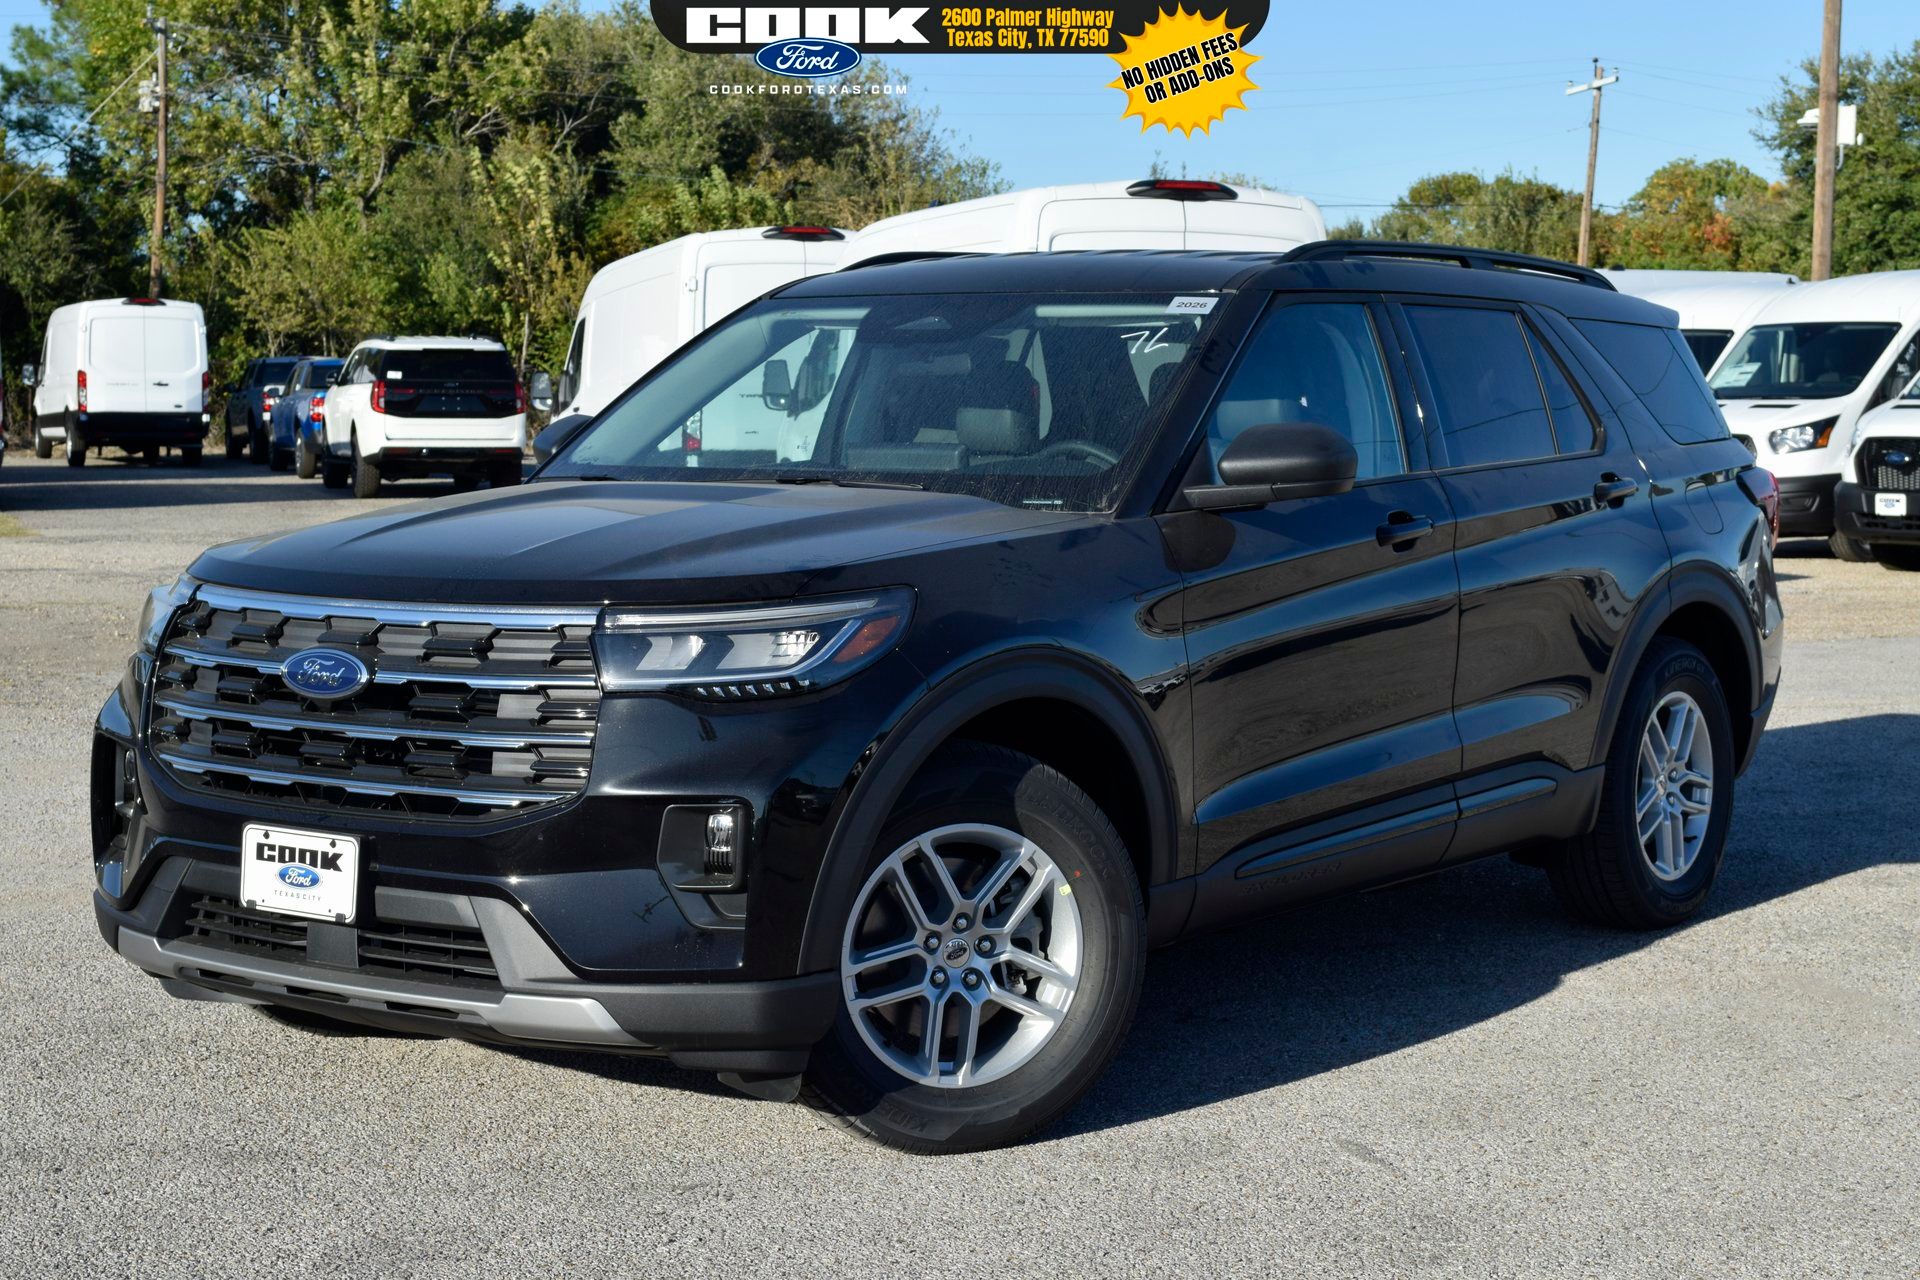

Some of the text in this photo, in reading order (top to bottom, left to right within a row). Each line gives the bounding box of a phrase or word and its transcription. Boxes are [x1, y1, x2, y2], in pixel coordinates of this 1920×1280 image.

[1175, 301, 1208, 309] 2026
[297, 657, 346, 687] Ford
[256, 842, 344, 872] COOK
[285, 867, 312, 887] Ford
